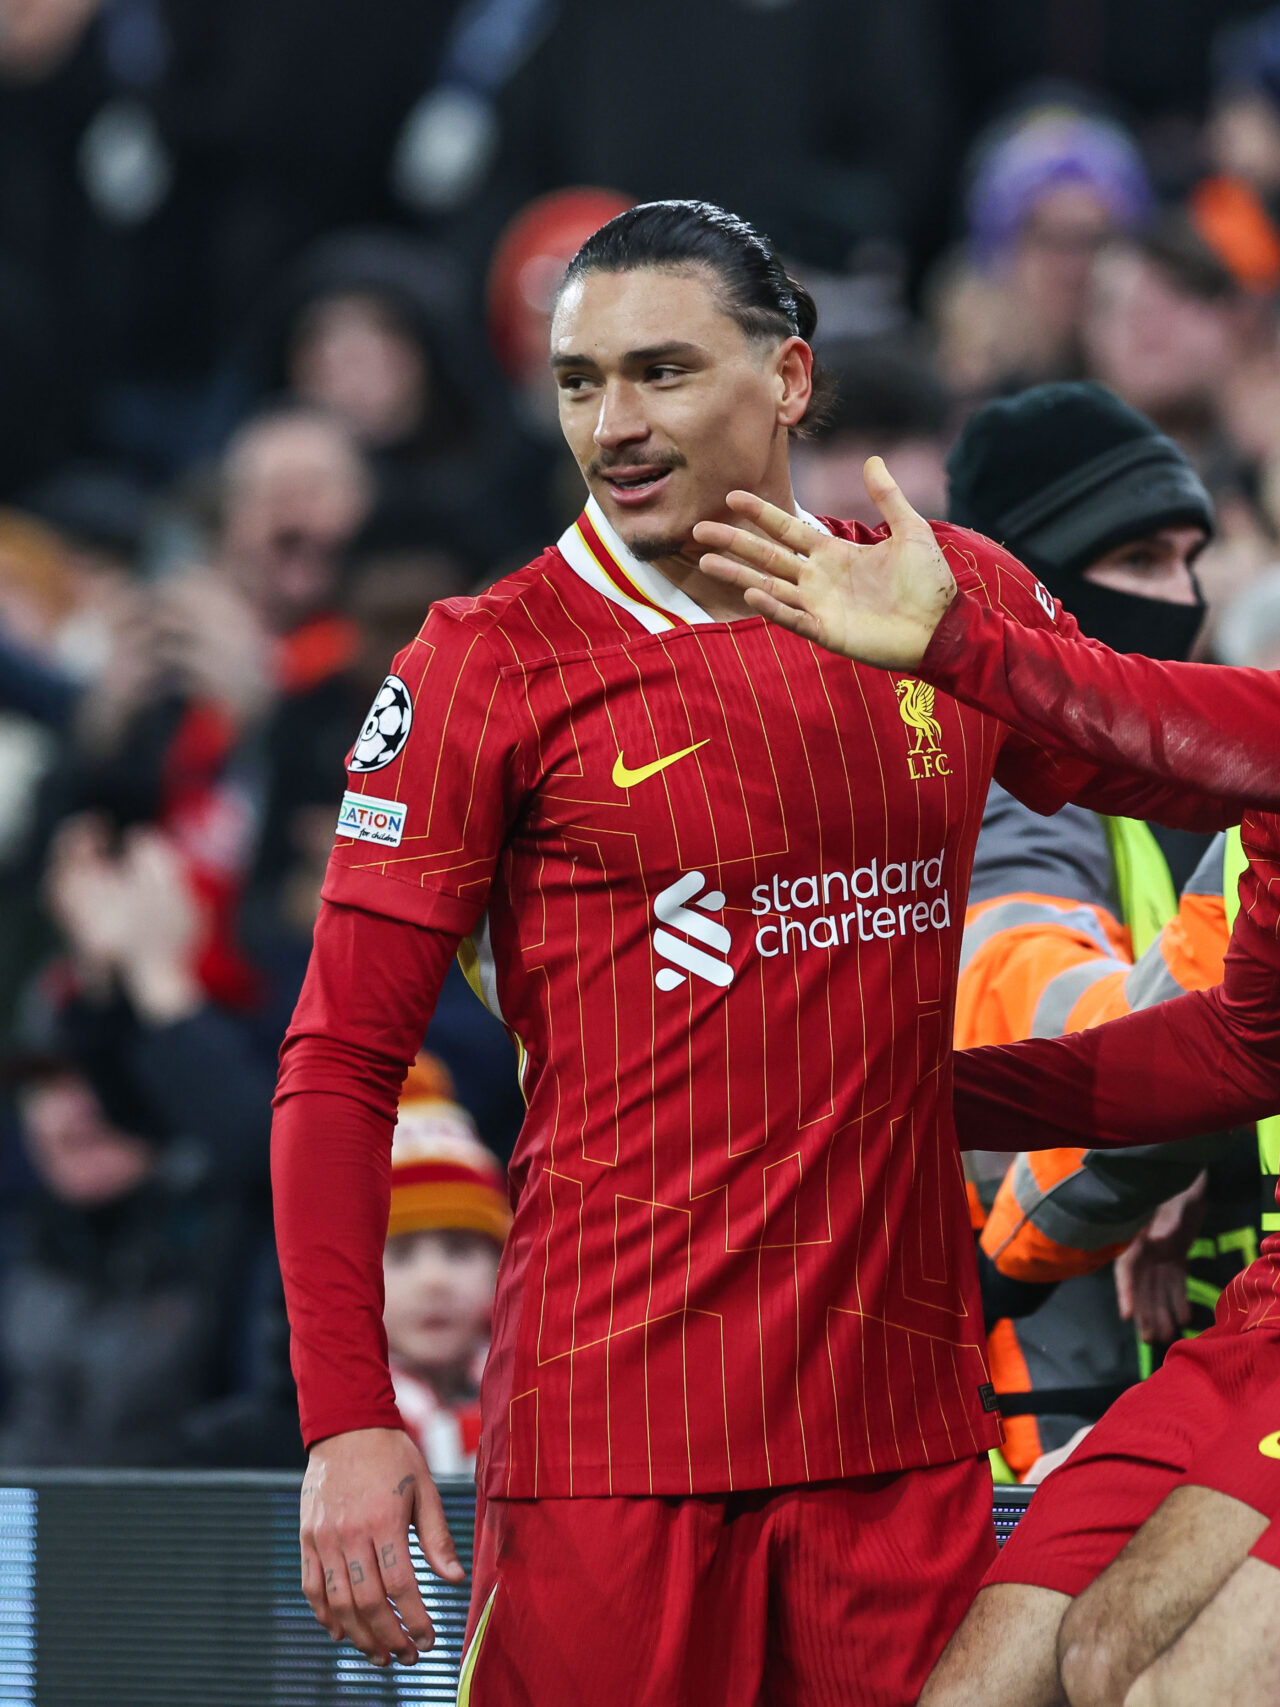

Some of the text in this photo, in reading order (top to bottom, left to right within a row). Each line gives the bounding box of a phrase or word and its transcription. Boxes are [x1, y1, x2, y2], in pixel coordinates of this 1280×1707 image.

[359, 828, 398, 844] for children
[751, 848, 945, 916] standard
[755, 889, 951, 957] chartered
